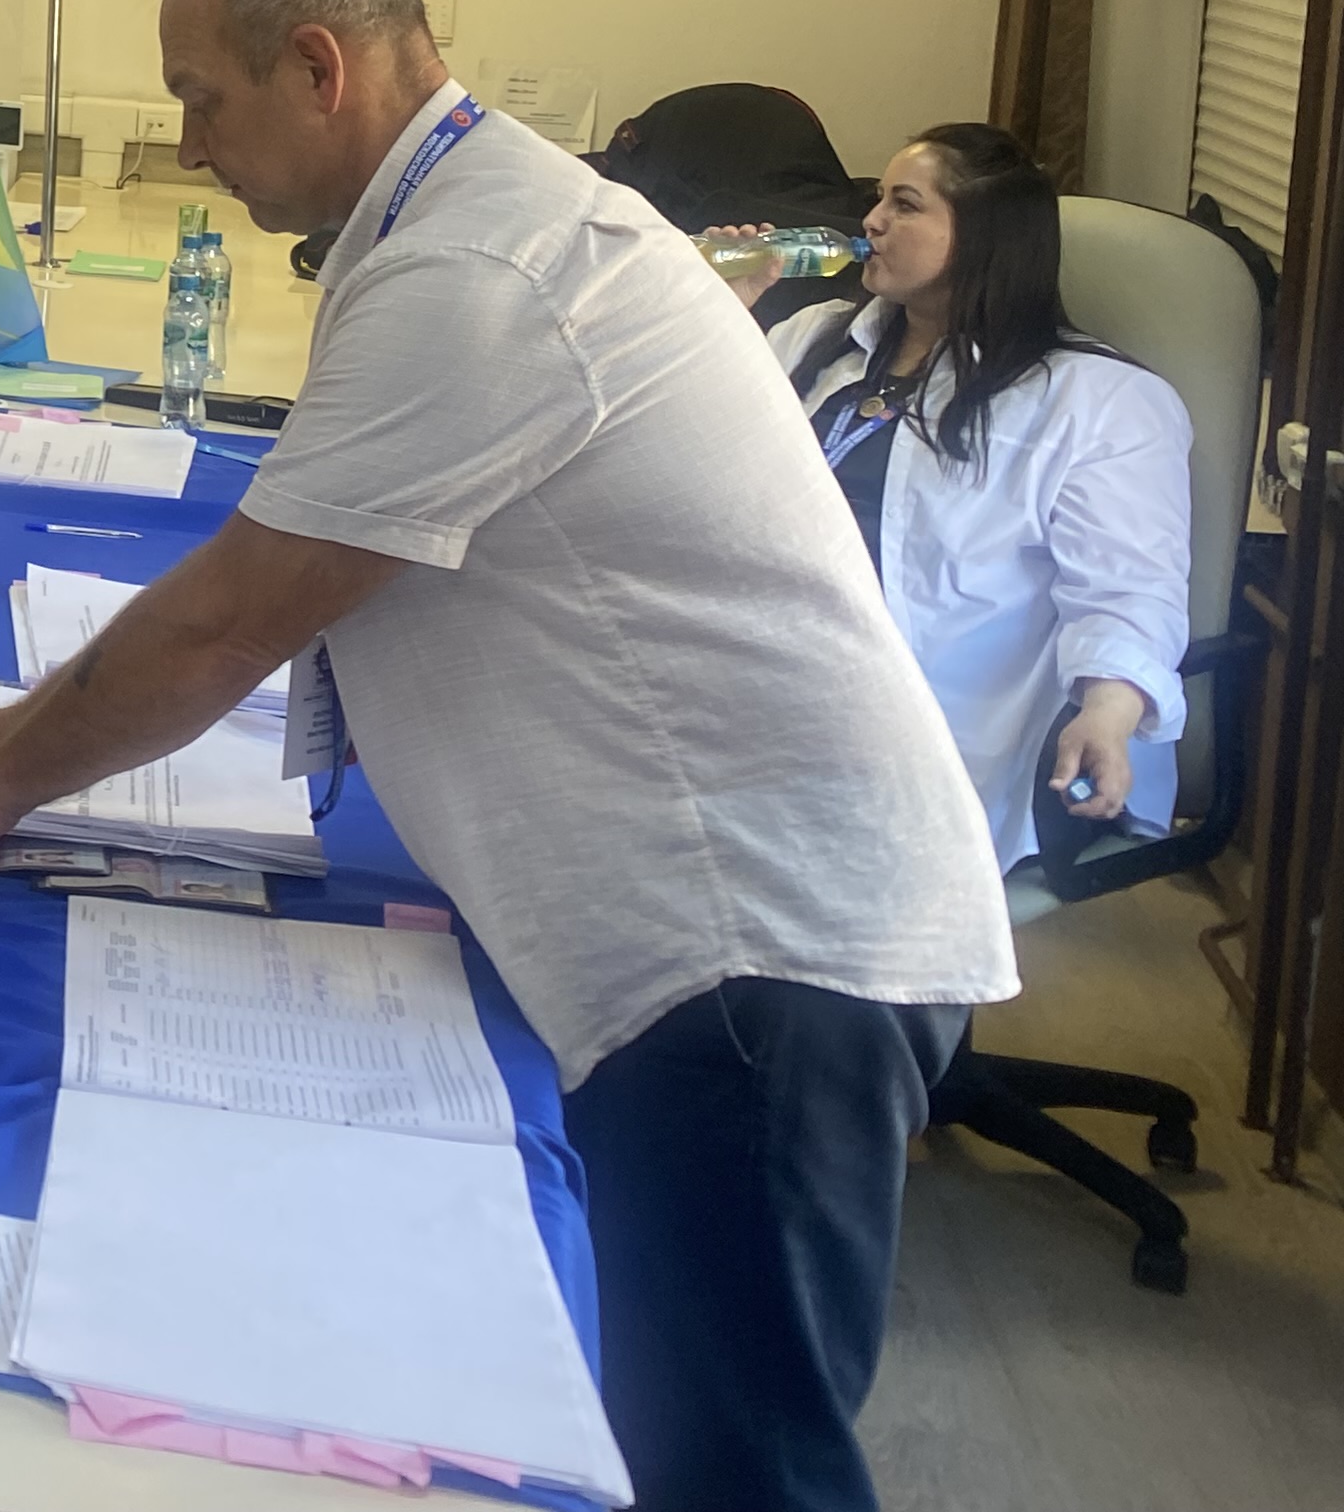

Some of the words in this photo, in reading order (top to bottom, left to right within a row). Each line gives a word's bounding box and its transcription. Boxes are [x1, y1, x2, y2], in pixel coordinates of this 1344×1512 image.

[404, 132, 442, 181] МОСКОВСКОЙ
[412, 131, 456, 188] ИЗБИРАТЕЛЬНАЯ
[389, 179, 409, 216] ОБЛАСТИ
